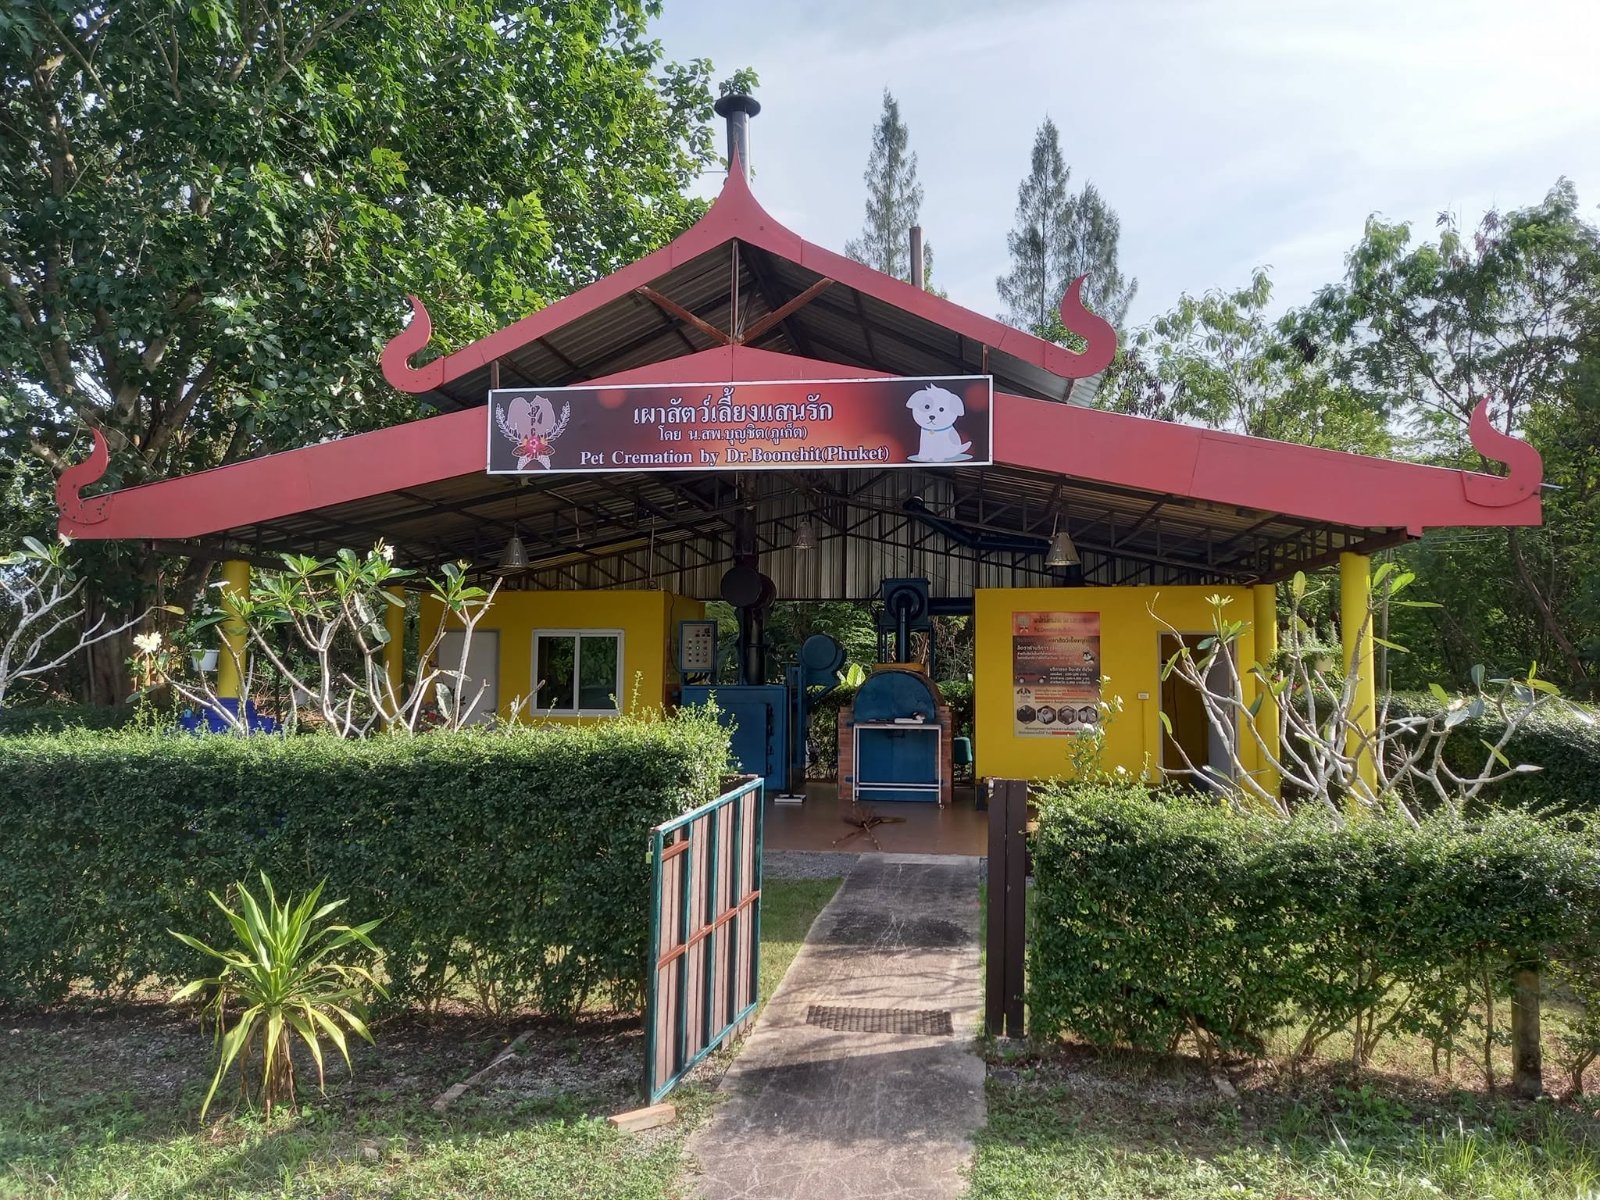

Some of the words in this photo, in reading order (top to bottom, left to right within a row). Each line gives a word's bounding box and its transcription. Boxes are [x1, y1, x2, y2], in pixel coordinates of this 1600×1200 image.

[633, 387, 833, 424] เผาสัตว์เลี้ยงแสนรัก
[658, 425, 682, 441] โดย
[580, 451, 605, 465] Pet
[611, 449, 693, 465] Cremation
[699, 449, 719, 466] by
[726, 446, 889, 463] Dr.Boonchit(Phuket)
